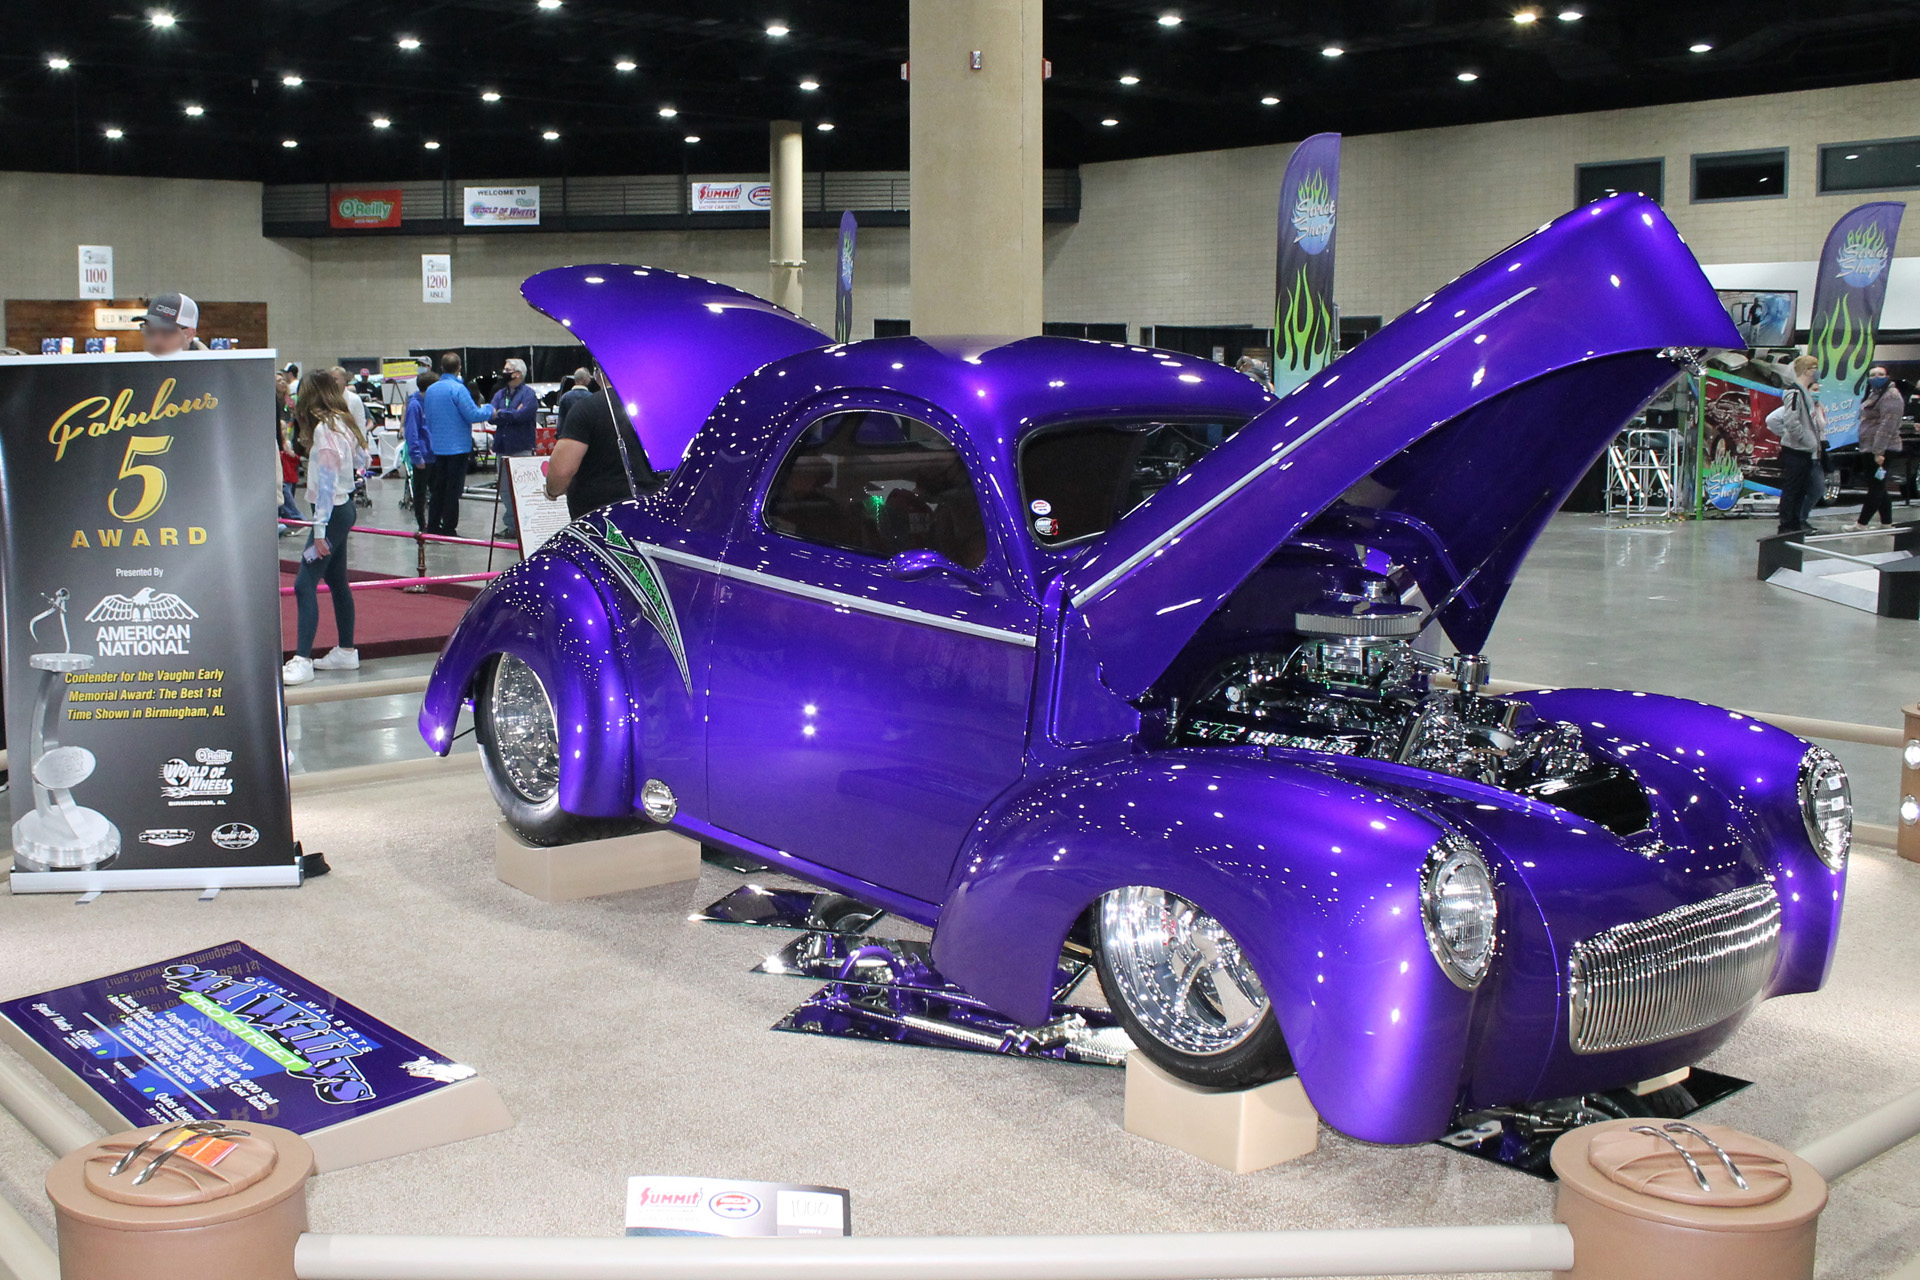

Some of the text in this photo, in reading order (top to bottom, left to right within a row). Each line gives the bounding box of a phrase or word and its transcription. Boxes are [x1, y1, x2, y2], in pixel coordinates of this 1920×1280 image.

[339, 199, 393, 219] O'Reilly
[472, 206, 537, 218] WORLD OF WHEELS
[86, 268, 108, 283] 1100
[427, 275, 448, 289] 1200
[88, 286, 106, 294] AISLE
[48, 377, 219, 463] Fabulous
[108, 434, 174, 523] 5
[71, 526, 208, 549] AWARD
[116, 567, 164, 578] Presented By
[96, 624, 190, 642] AMERICAN
[98, 639, 190, 656] NATIONAL
[64, 668, 224, 684] Contender for the Vaughn Early
[68, 686, 223, 702] Memorial Award: The Best 1st
[68, 706, 226, 720] Time Shown in Birmingham, AL
[195, 748, 233, 763] O'Reilly
[165, 764, 227, 778] WORLD OF
[189, 778, 234, 793] WHEELS
[244, 976, 373, 1054] QUINT WALBERTS
[184, 992, 305, 1068] PRO STREET
[154, 1018, 170, 1029] 400
[204, 1055, 226, 1069] Body
[238, 1079, 263, 1093] 4000
[260, 1092, 280, 1106] Stall
[238, 1062, 254, 1072] HP
[168, 1064, 196, 1084] Chassis
[229, 1083, 250, 1098] Gear
[247, 1092, 268, 1112] Ratio
